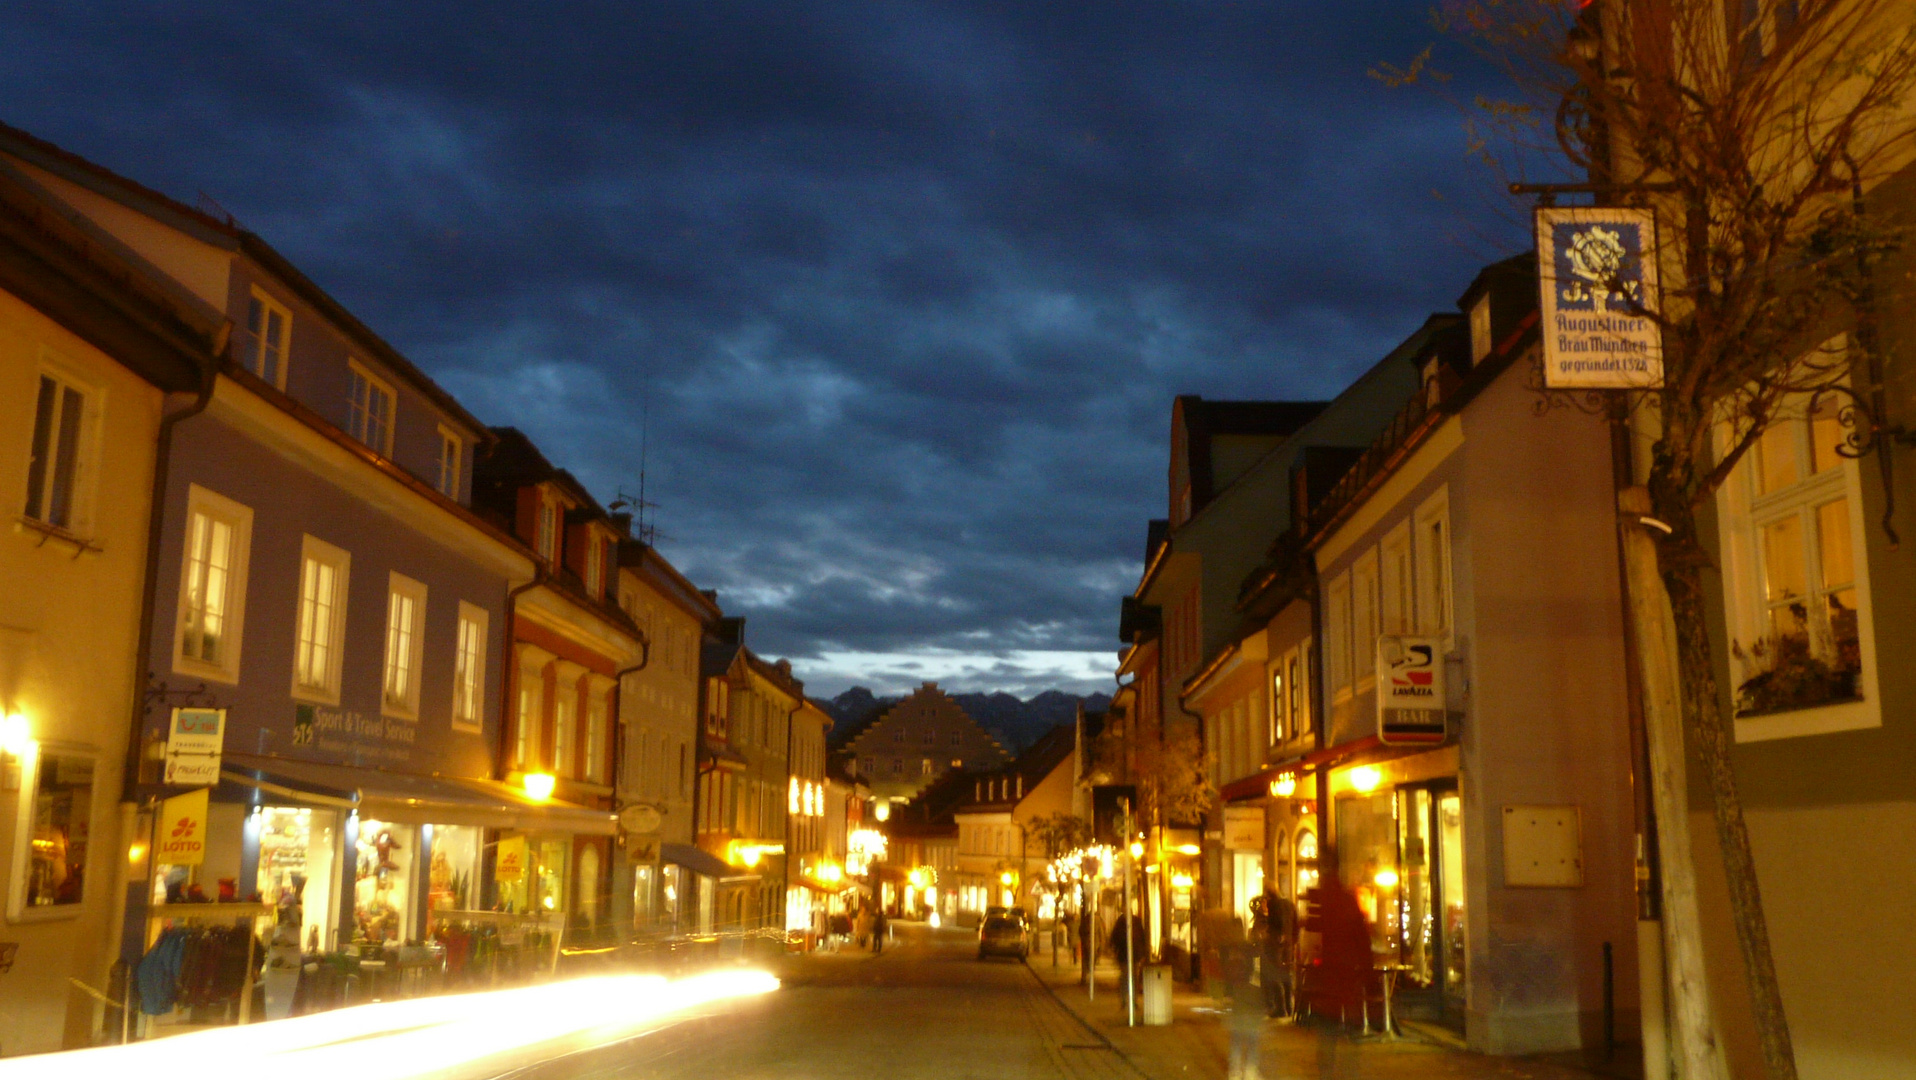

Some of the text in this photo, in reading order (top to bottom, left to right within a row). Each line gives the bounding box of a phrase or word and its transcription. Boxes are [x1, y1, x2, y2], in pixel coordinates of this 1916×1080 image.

[1392, 686, 1433, 696] LAVAZZA
[1396, 709, 1431, 724] BAR
[315, 705, 416, 743] Sport & Travel Service
[163, 841, 202, 852] LOTTO
